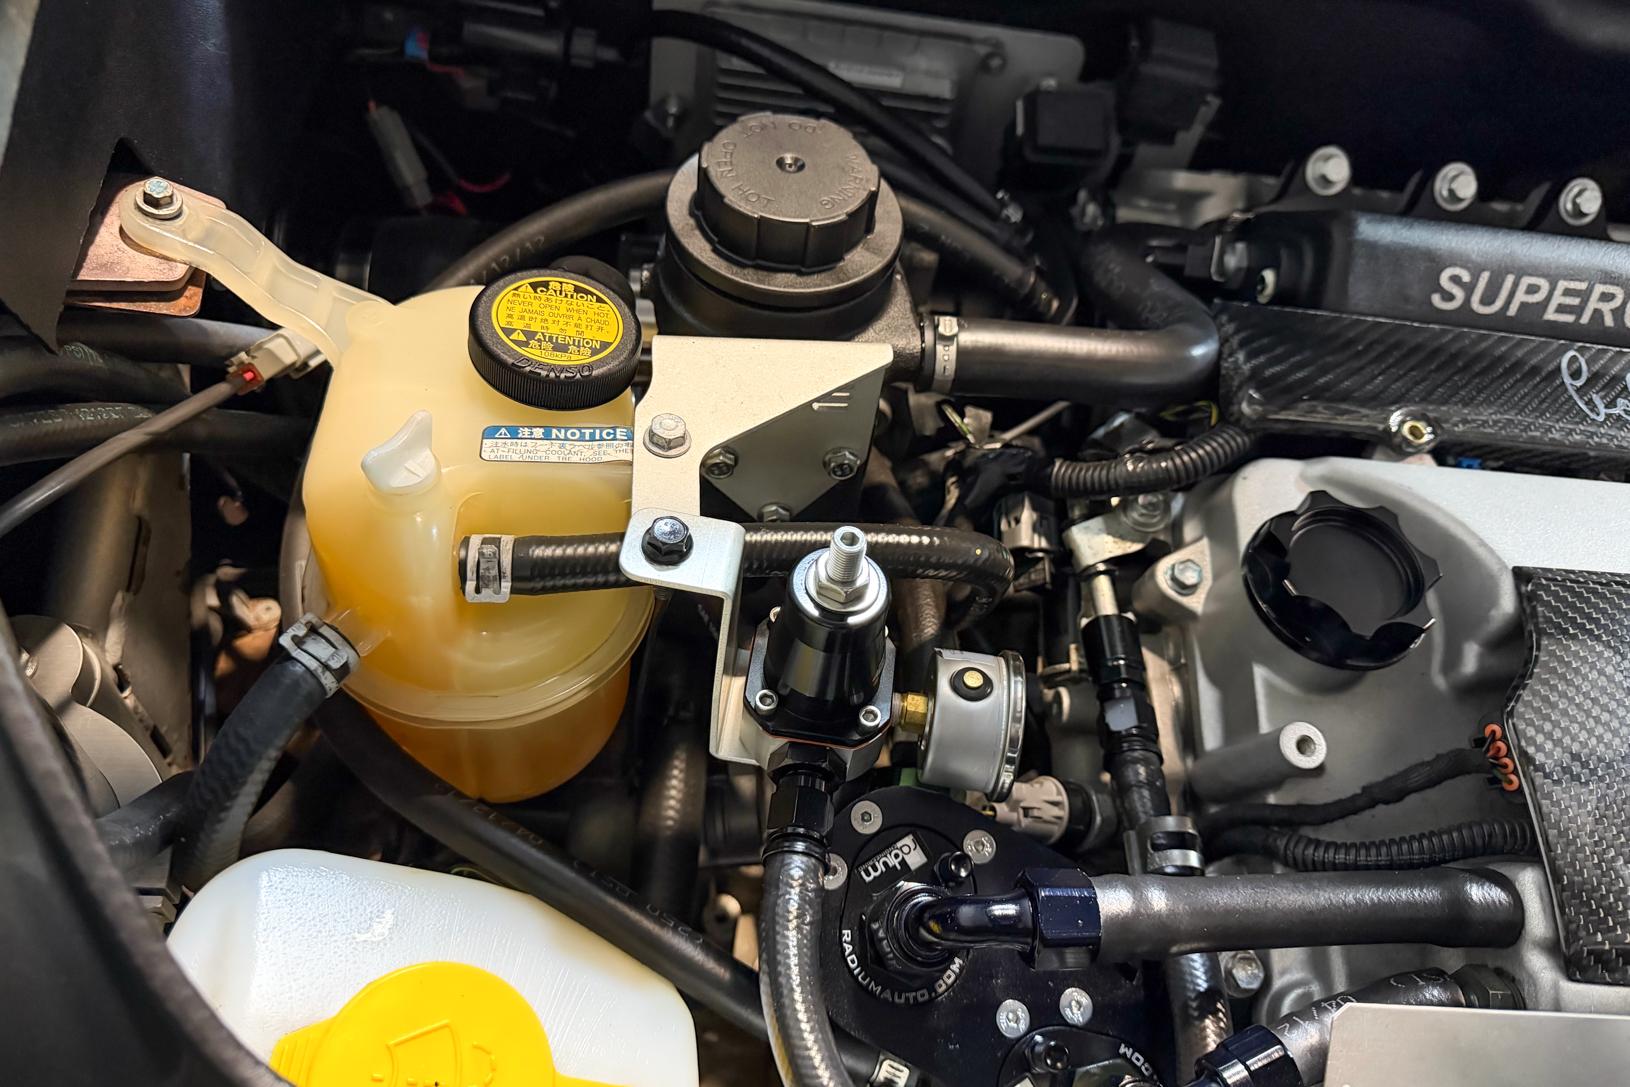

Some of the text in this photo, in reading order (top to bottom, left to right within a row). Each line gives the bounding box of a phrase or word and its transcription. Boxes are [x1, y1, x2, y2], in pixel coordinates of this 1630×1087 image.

[731, 183, 776, 209] HOT
[536, 286, 597, 303] CAUTION
[1430, 265, 1630, 330] SUPER
[506, 299, 533, 308] NEVER
[539, 303, 561, 312] OPEN
[566, 306, 588, 316] WHEN
[519, 308, 545, 317] JAMAIS
[548, 311, 575, 321] OUVRIR
[534, 332, 601, 350] ATTENTION
[511, 357, 594, 378] DENSO
[517, 426, 545, 439] 注意
[551, 428, 628, 440] NOTICE
[859, 835, 918, 884] radium
[841, 928, 965, 1003] RADIUMAUTO.COM
